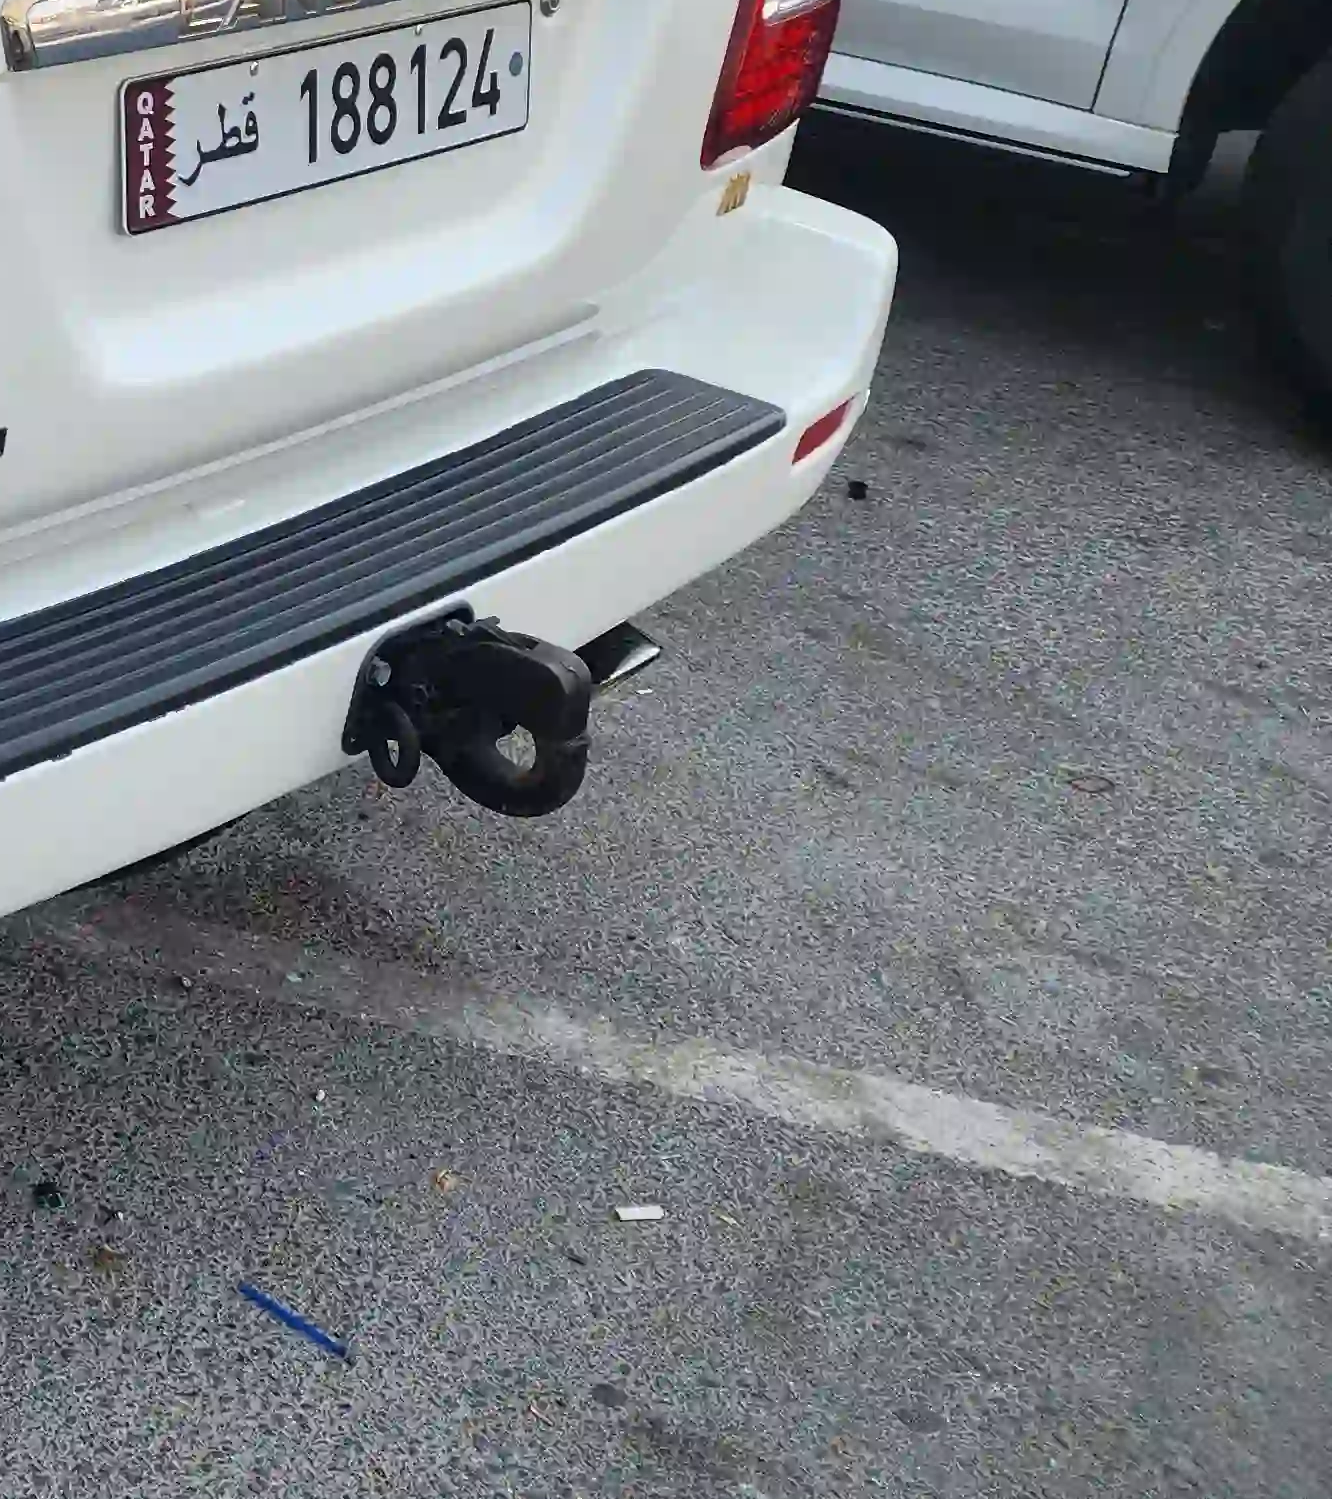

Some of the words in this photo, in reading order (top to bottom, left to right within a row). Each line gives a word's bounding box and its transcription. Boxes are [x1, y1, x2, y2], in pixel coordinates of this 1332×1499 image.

[135, 91, 157, 219] QATAR
[177, 91, 260, 187] قطر
[299, 28, 502, 164] 188124
